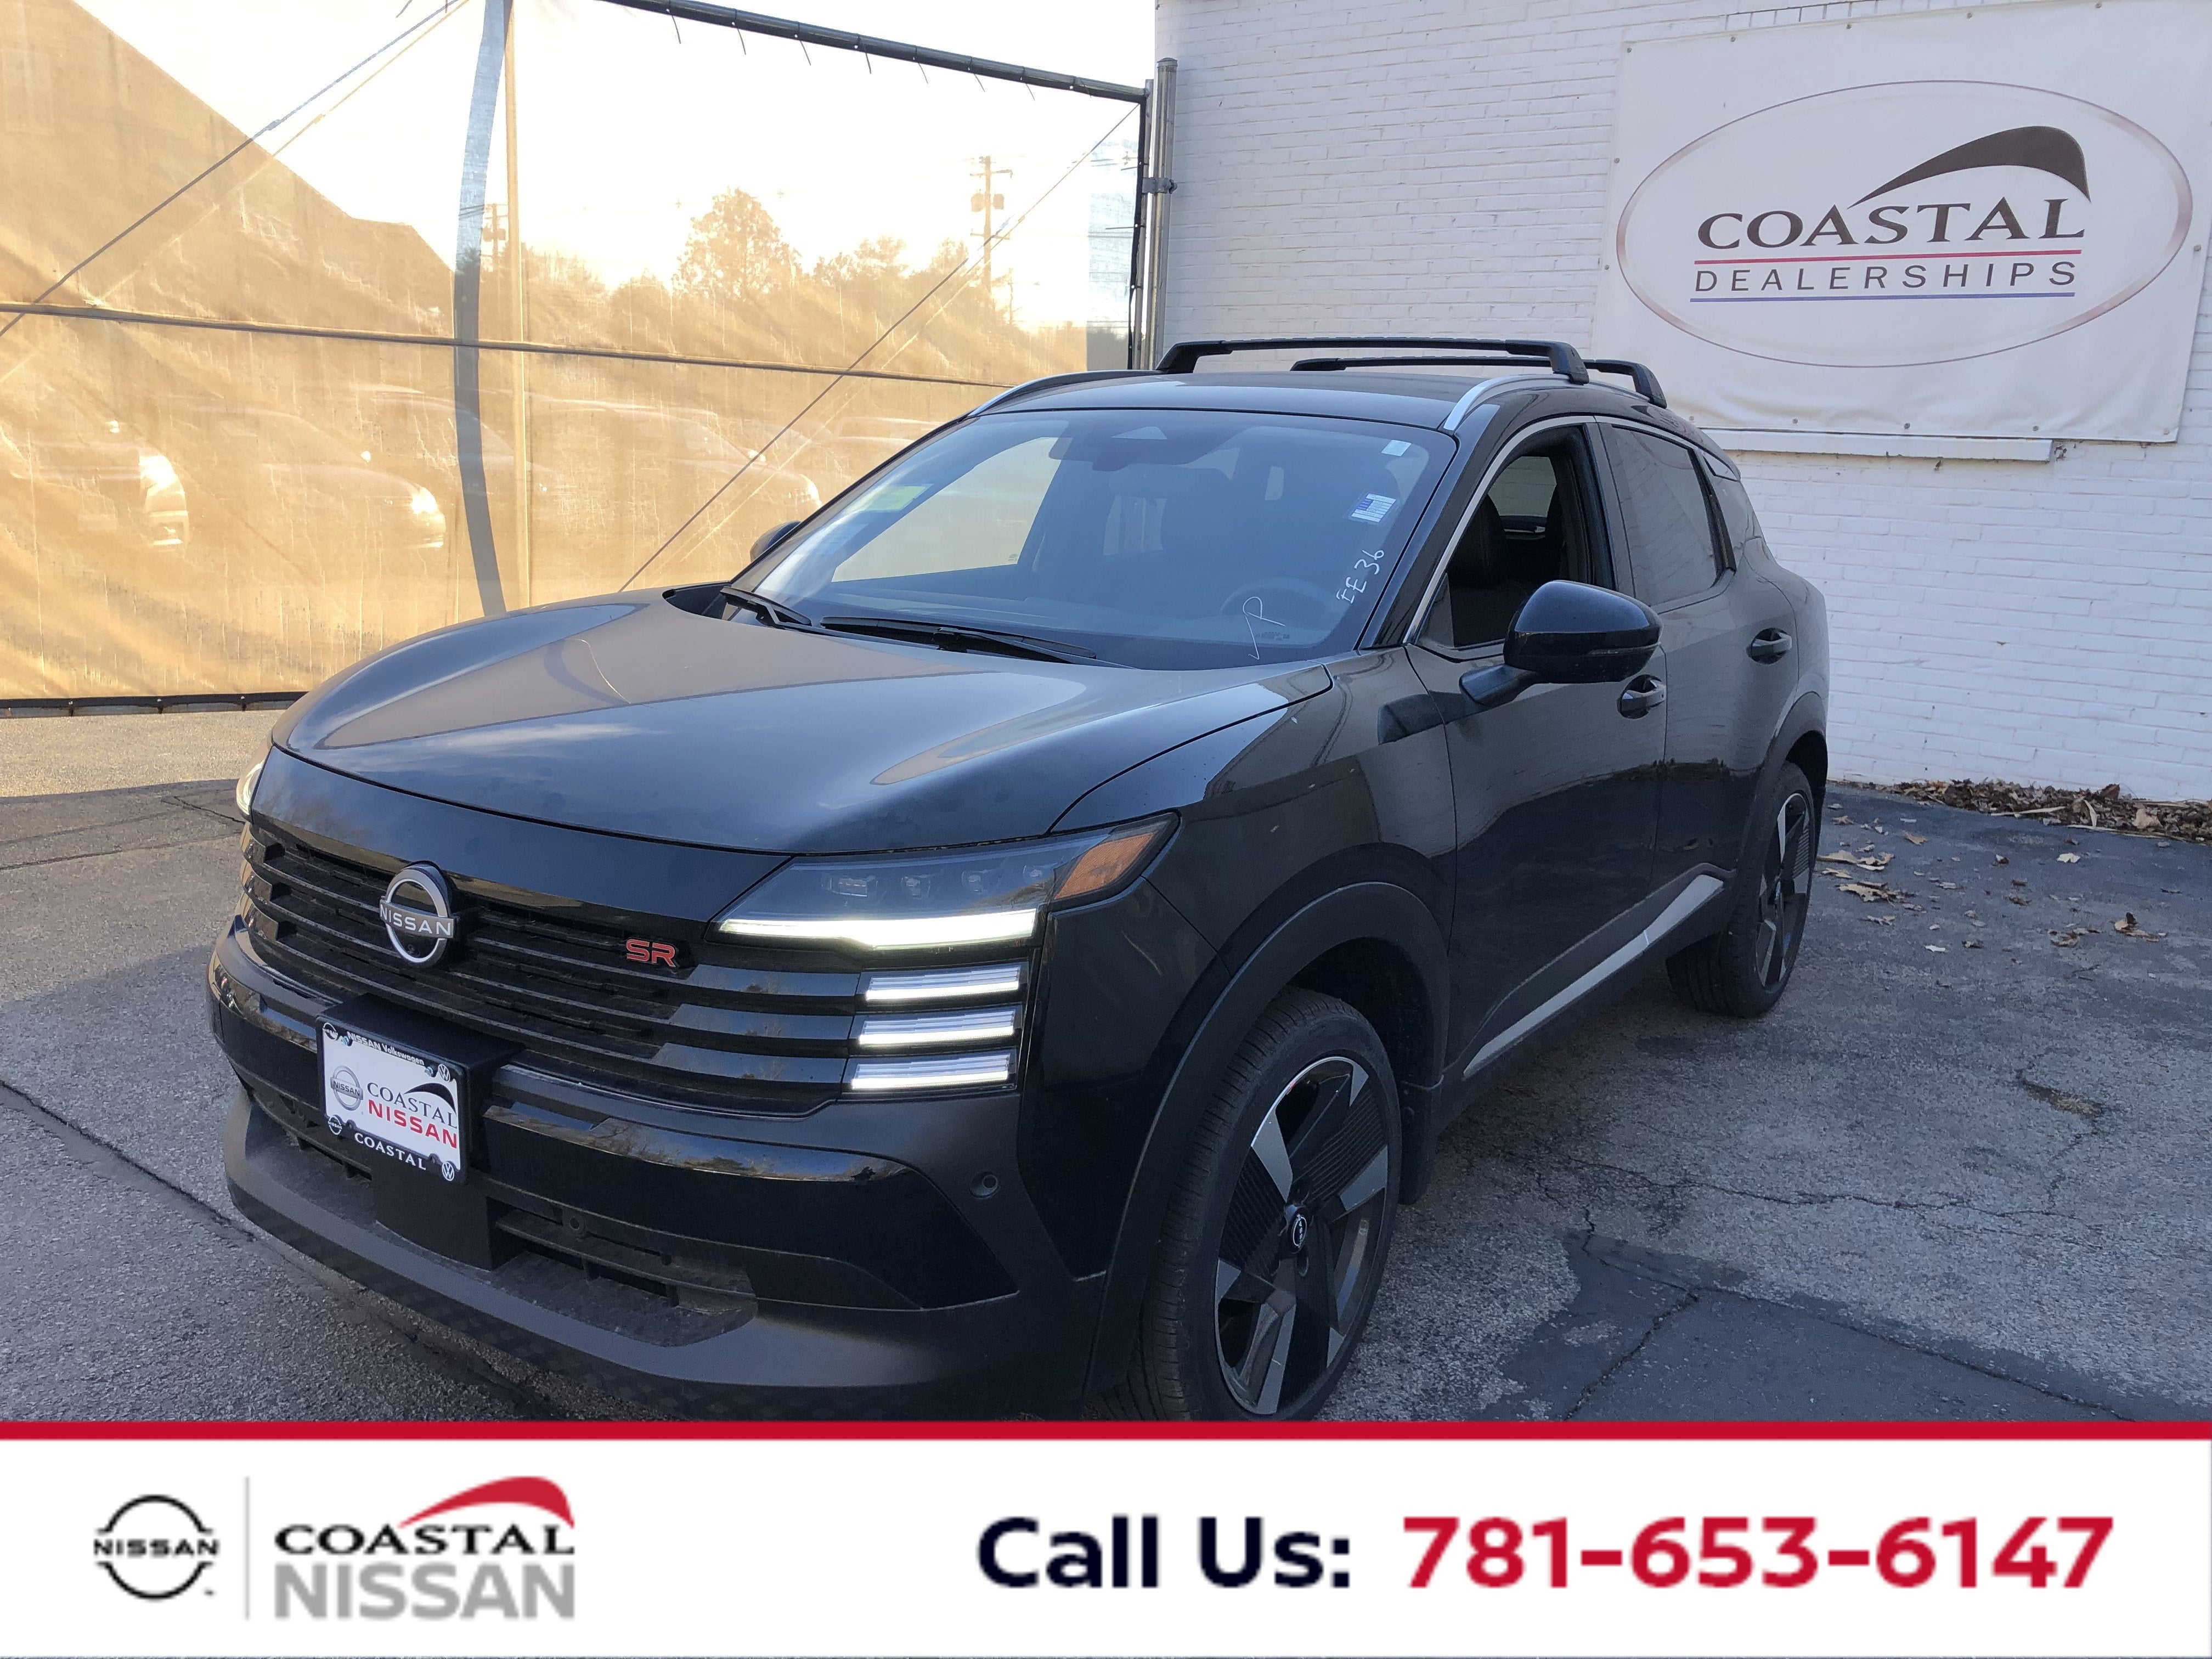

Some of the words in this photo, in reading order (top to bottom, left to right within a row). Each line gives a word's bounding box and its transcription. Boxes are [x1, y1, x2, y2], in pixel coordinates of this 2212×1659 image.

[1697, 196, 2085, 249] COASTAL
[1696, 261, 2075, 292] DEALERSHIPS
[380, 905, 452, 936] NISSAN
[626, 939, 675, 968] SR
[347, 1031, 382, 1052] NISSAN
[382, 1043, 425, 1066] Volkswagen
[332, 1080, 361, 1097] NISSAN
[367, 1082, 458, 1129] COASTAL
[368, 1099, 458, 1149] NISSAN
[354, 1132, 427, 1171] COASTAL
